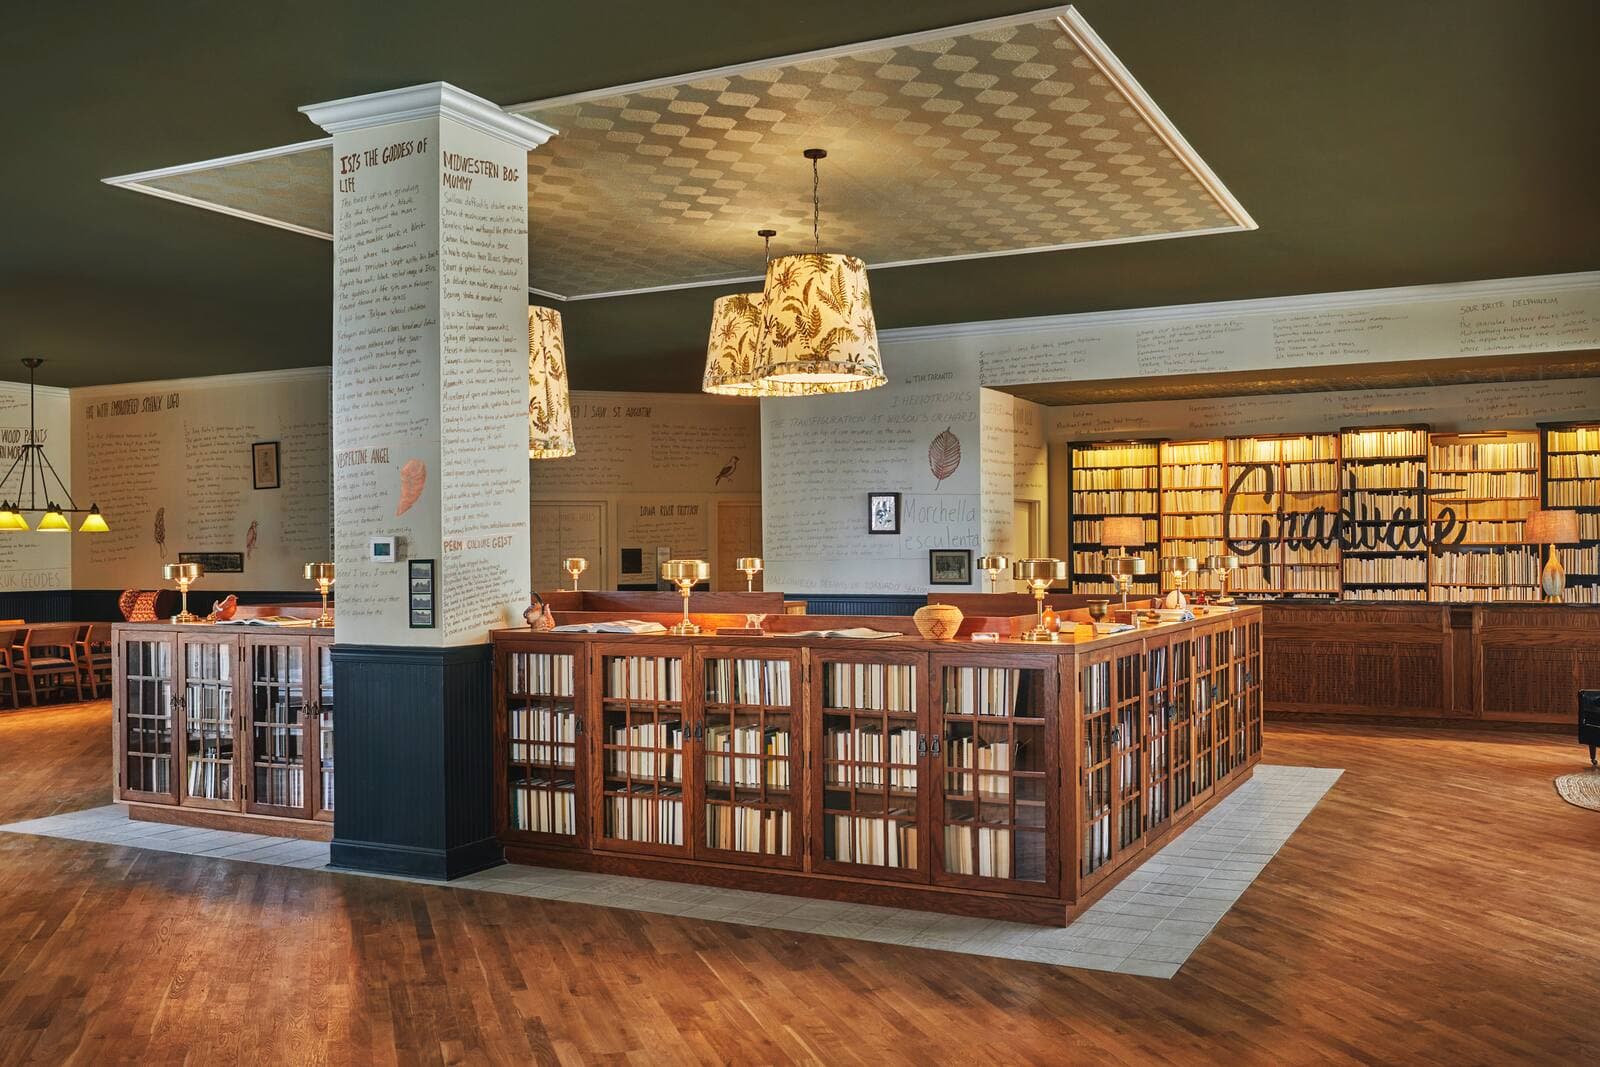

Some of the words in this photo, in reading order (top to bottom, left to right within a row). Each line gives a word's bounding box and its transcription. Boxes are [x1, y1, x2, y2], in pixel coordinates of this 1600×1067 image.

[340, 153, 361, 174] ISIS
[364, 148, 378, 167] THE
[382, 141, 414, 164] GODDESS
[417, 137, 428, 154] OF
[442, 151, 499, 179] MIDWESTERN
[502, 166, 520, 182] BOG
[442, 172, 473, 192] MUMMY
[913, 374, 926, 383] TIM
[166, 393, 180, 410] LOGO
[591, 405, 608, 418] SAW
[790, 415, 866, 427] TRANSFIGURATION
[871, 413, 882, 424] AT
[931, 411, 977, 424] ORCHARD
[1, 429, 21, 444] WOOD
[24, 428, 48, 445] PANTS
[336, 449, 368, 468] VESPERTINE
[371, 447, 390, 464] ANGEL
[640, 505, 656, 517] IOWA
[660, 504, 675, 517] RIVER
[903, 498, 976, 526] Morchella
[1223, 464, 1467, 585] Graduate
[443, 540, 463, 554] PERM
[492, 535, 513, 549] GEIST
[904, 527, 979, 551] esculenta
[21, 571, 61, 589] GEODES
